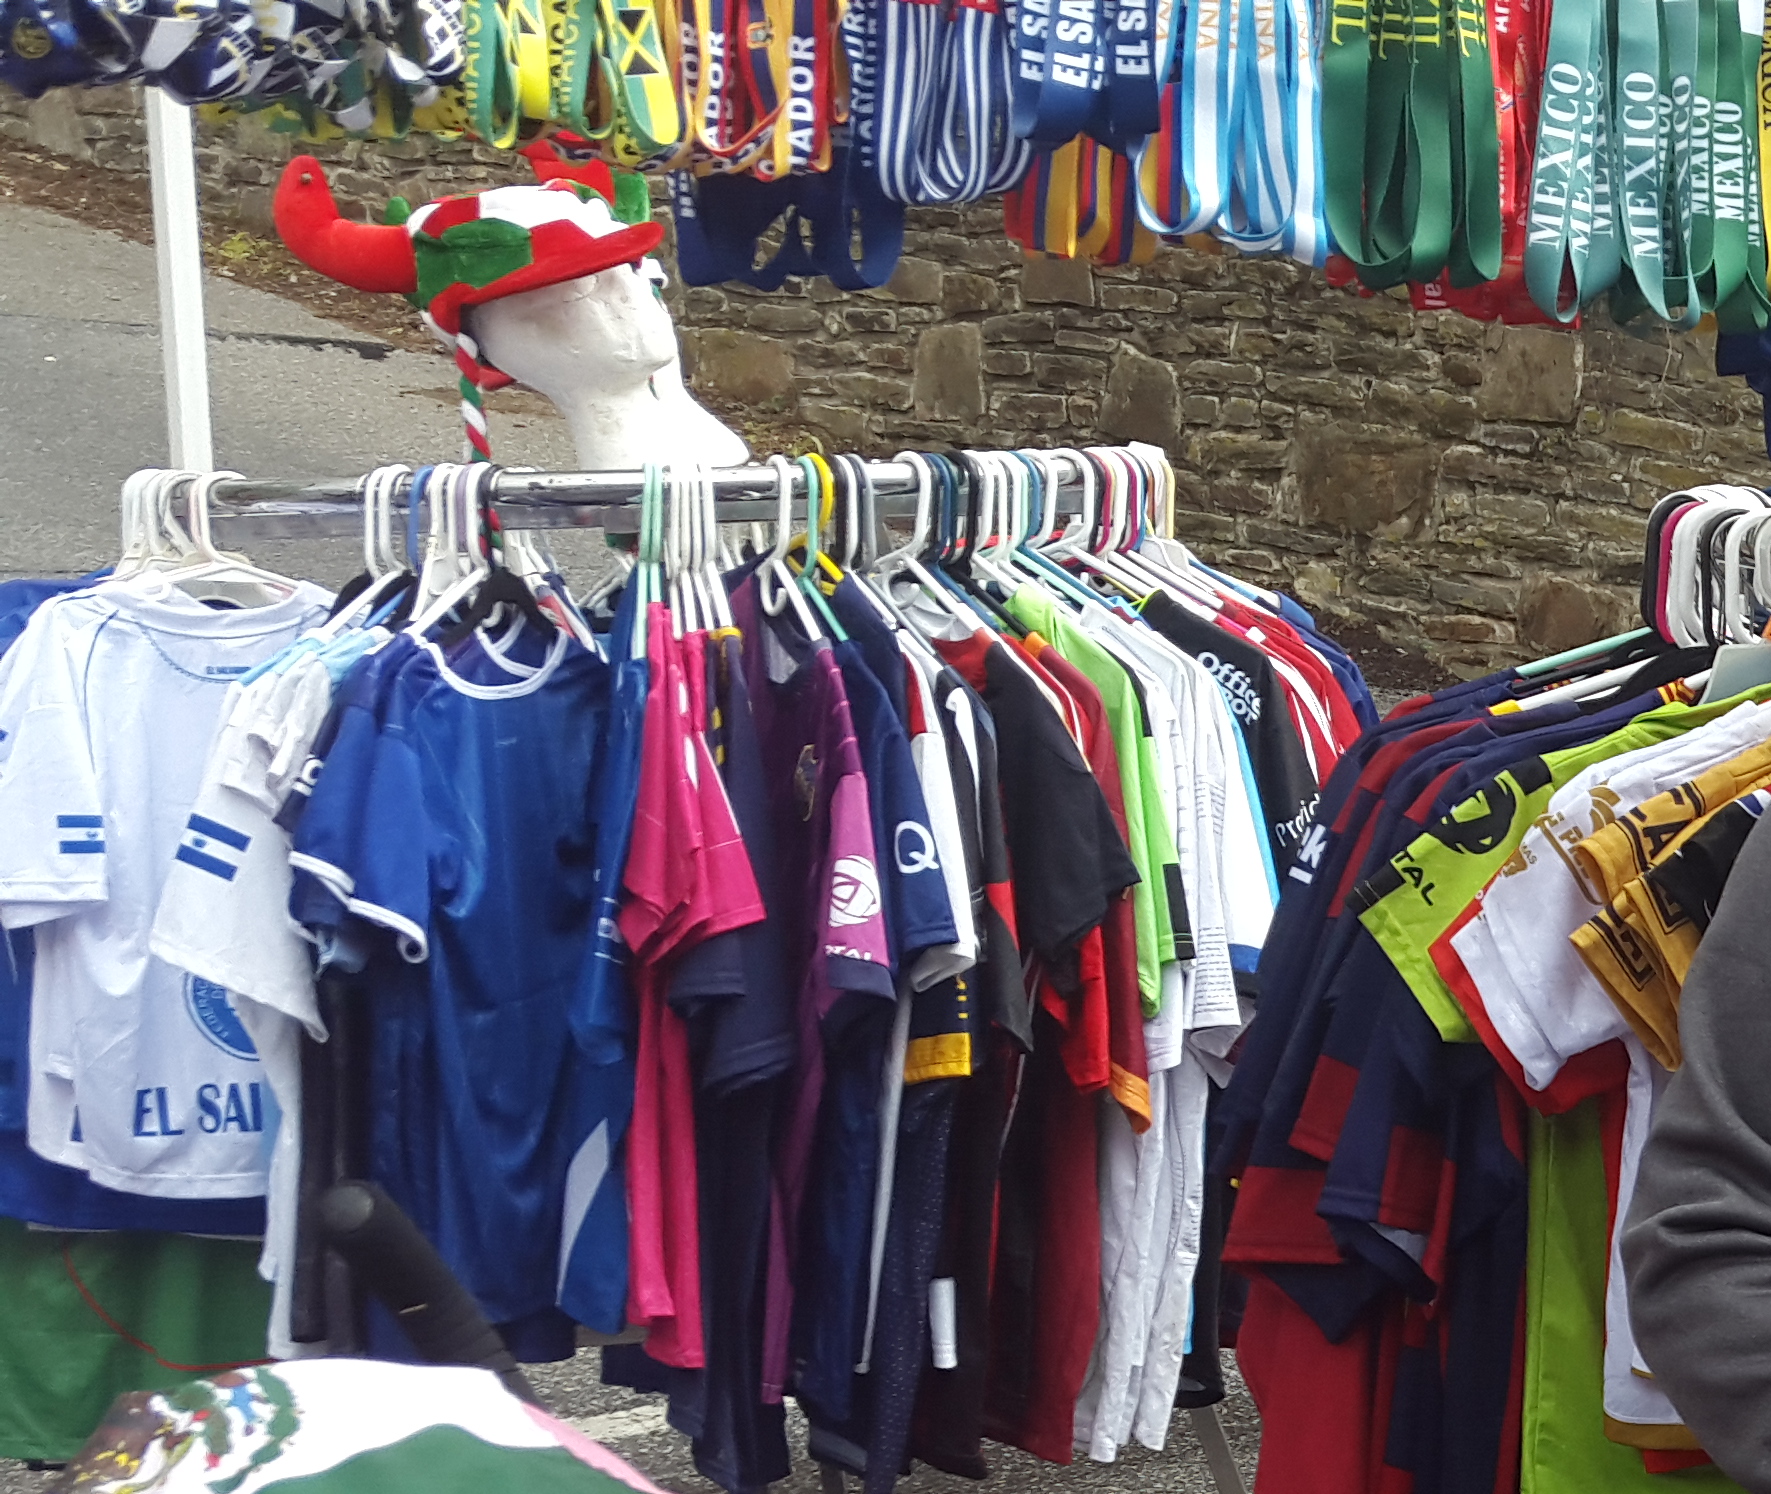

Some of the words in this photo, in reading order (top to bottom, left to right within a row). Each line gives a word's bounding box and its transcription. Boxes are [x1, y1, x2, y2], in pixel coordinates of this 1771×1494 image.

[1052, 52, 1092, 88] EL
[1114, 39, 1150, 75] EL
[1528, 63, 1583, 253] MEXICO
[1623, 72, 1661, 262] MEXICO
[1712, 101, 1746, 223] MEXICO
[132, 1086, 185, 1138] EL
